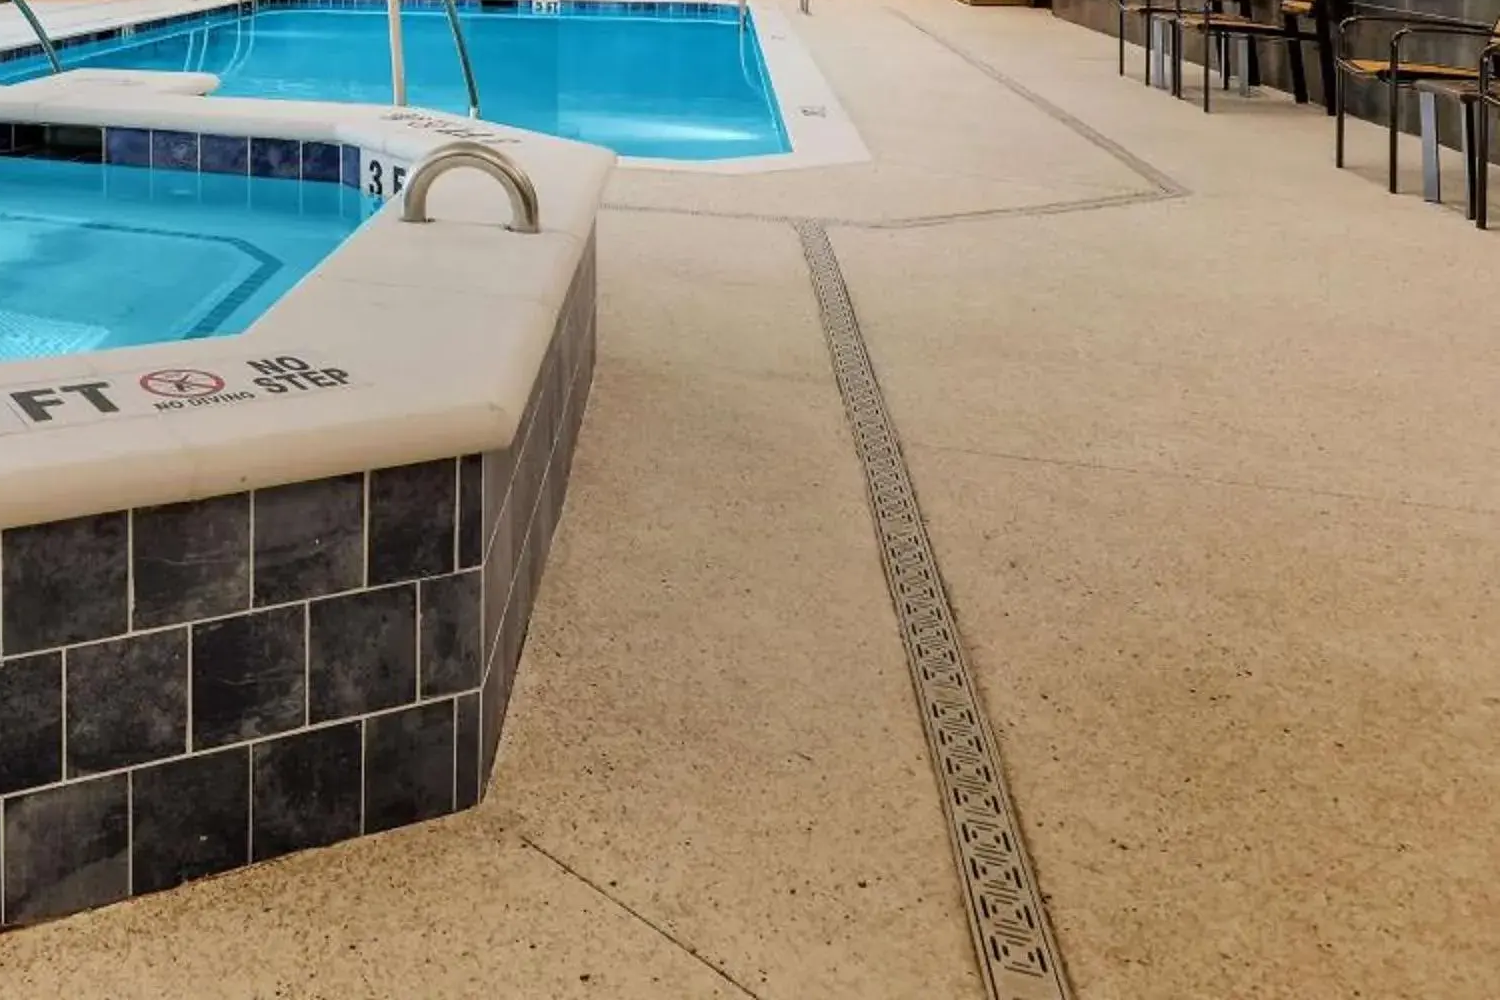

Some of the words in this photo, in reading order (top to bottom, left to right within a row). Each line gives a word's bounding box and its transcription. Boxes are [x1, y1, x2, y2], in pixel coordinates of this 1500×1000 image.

[369, 159, 383, 195] 3
[247, 356, 310, 375] NO
[253, 367, 349, 394] STEP
[9, 381, 120, 422] FT
[153, 400, 184, 411] NO
[187, 391, 256, 407] DIVING
